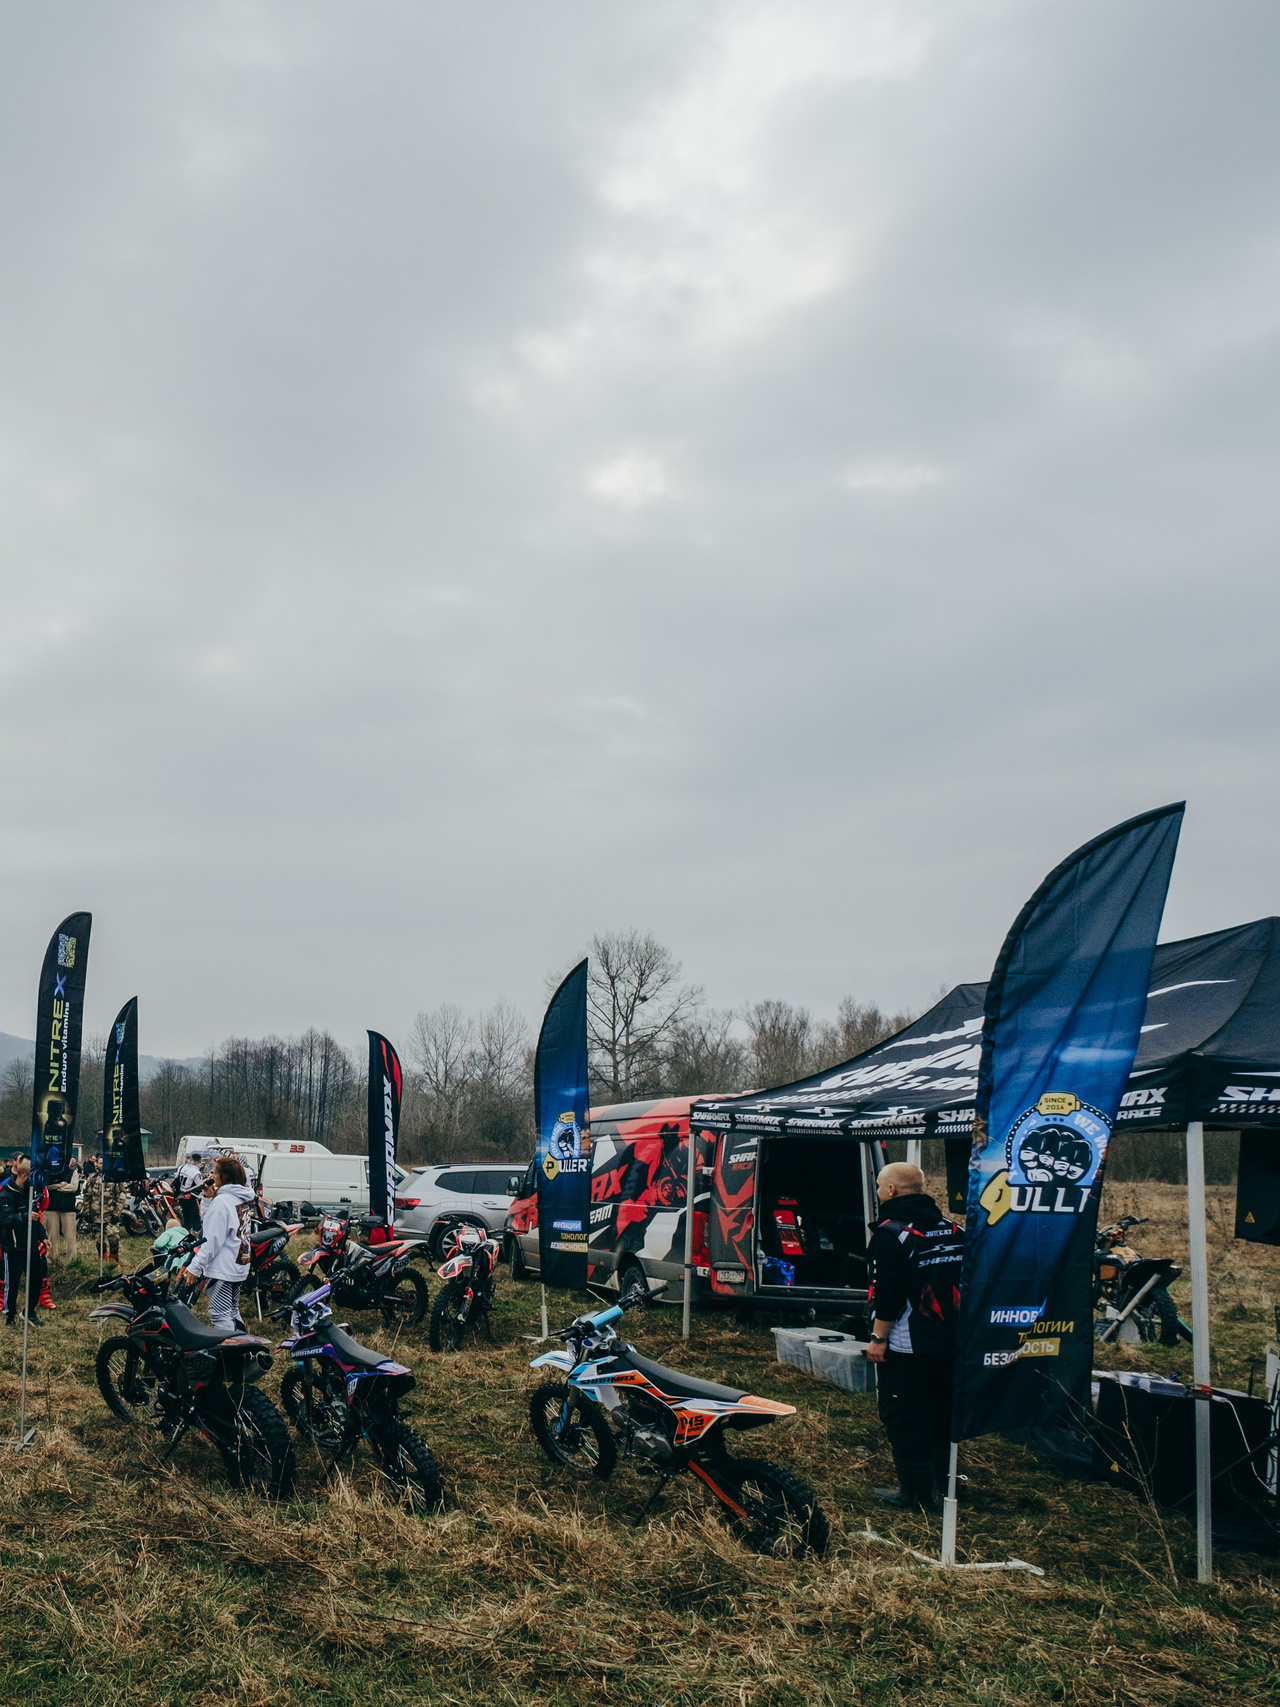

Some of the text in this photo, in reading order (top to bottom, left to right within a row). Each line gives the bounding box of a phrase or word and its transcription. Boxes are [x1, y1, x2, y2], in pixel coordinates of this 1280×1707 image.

[48, 972, 67, 1092] NITREX
[60, 1001, 70, 1093] Enduro vitamins
[691, 1111, 732, 1122] SHARMAX
[734, 1113, 785, 1126] SHARMAX
[848, 1113, 927, 1128] SHARMAX
[1116, 1107, 1162, 1121] RACE
[900, 1126, 926, 1135] RACE
[289, 1144, 306, 1153] 33
[383, 1074, 396, 1227] SHARMAX
[731, 1162, 753, 1171] RACE
